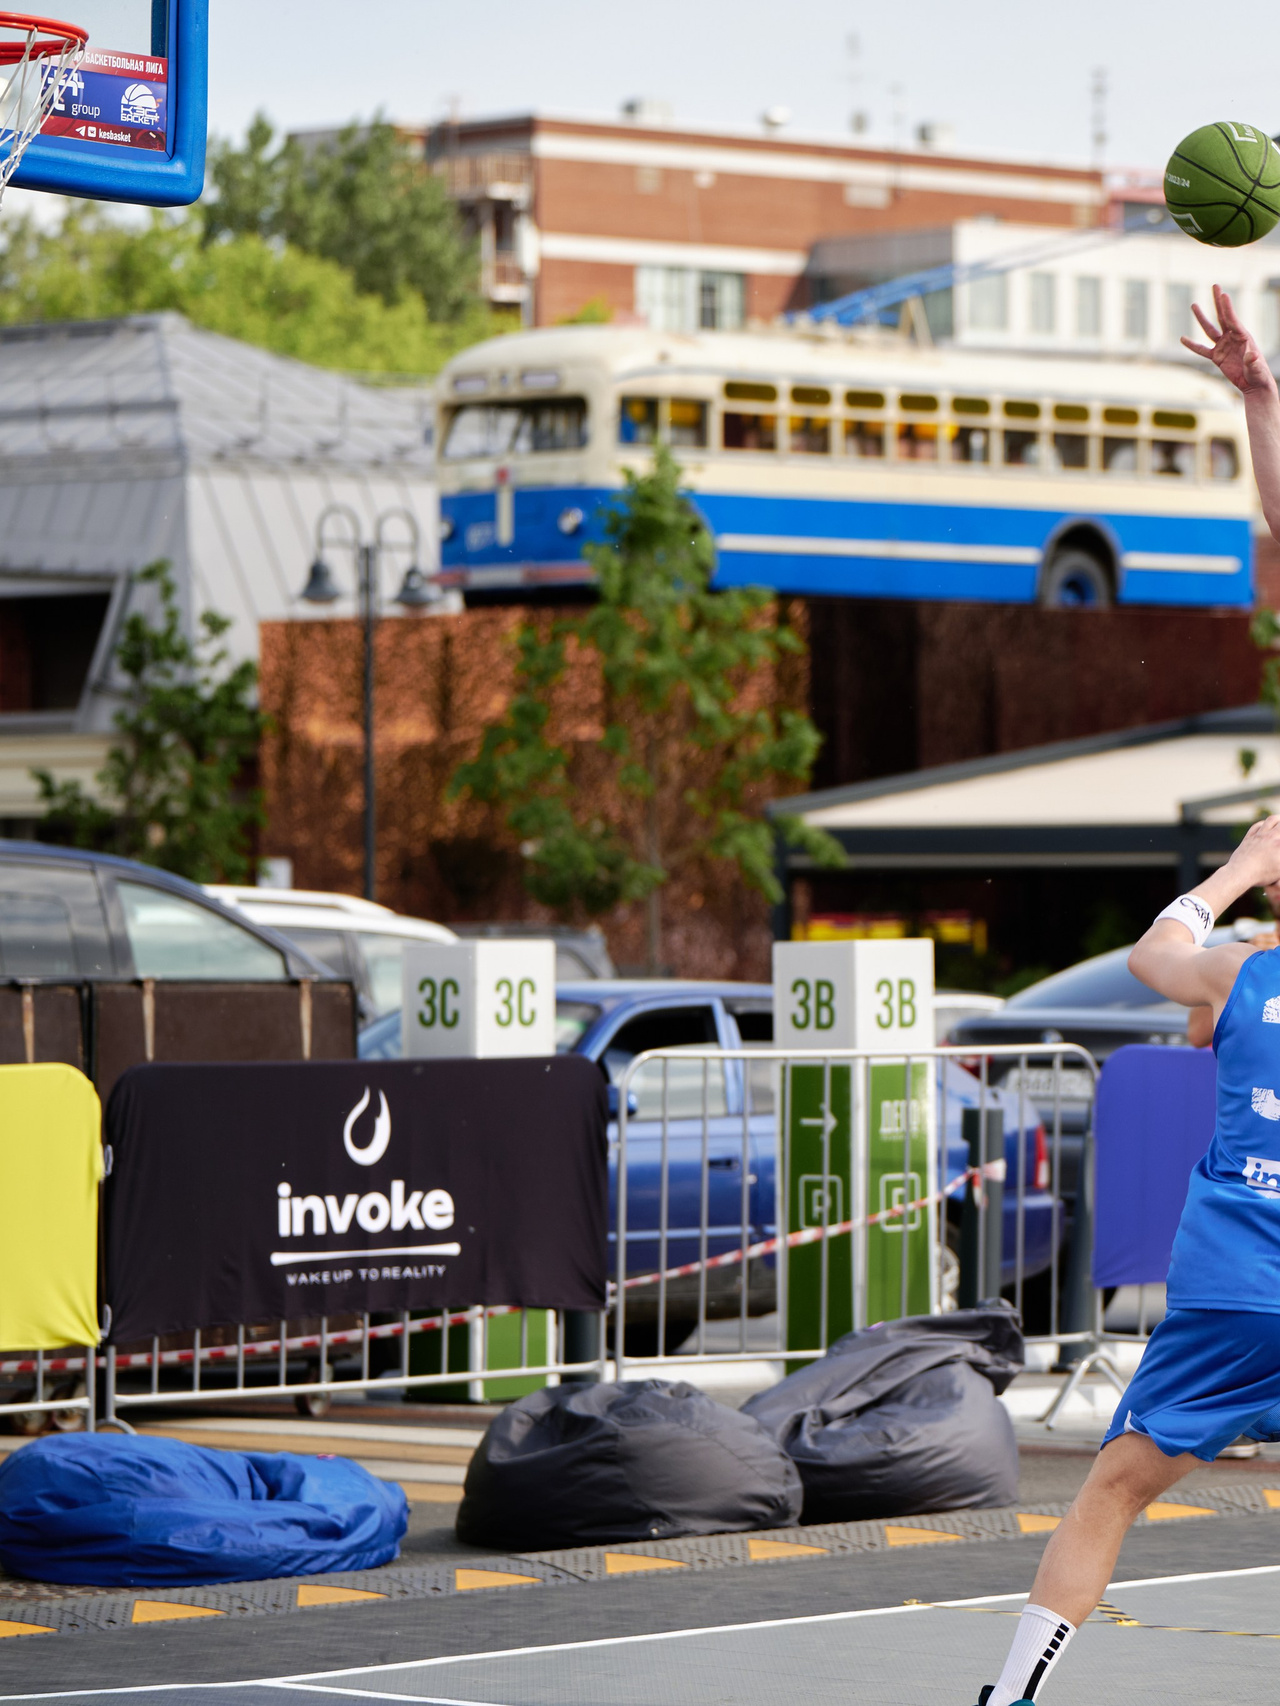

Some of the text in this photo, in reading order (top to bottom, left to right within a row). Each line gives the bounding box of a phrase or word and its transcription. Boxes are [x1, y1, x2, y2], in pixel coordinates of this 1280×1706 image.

[85, 53, 144, 72] БАСКЕТБОЛЬНАЯ
[145, 61, 164, 75] ЛИГА
[71, 103, 101, 119] group
[120, 113, 155, 126] БАСКЕТ
[98, 128, 132, 143] kesbasket
[417, 977, 460, 1029] 3C
[494, 977, 536, 1028] 3C
[790, 977, 836, 1031] 3B
[875, 977, 918, 1030] 3B
[277, 1179, 456, 1238] invoke
[286, 1264, 446, 1287] WAKE UP TO REALITY
